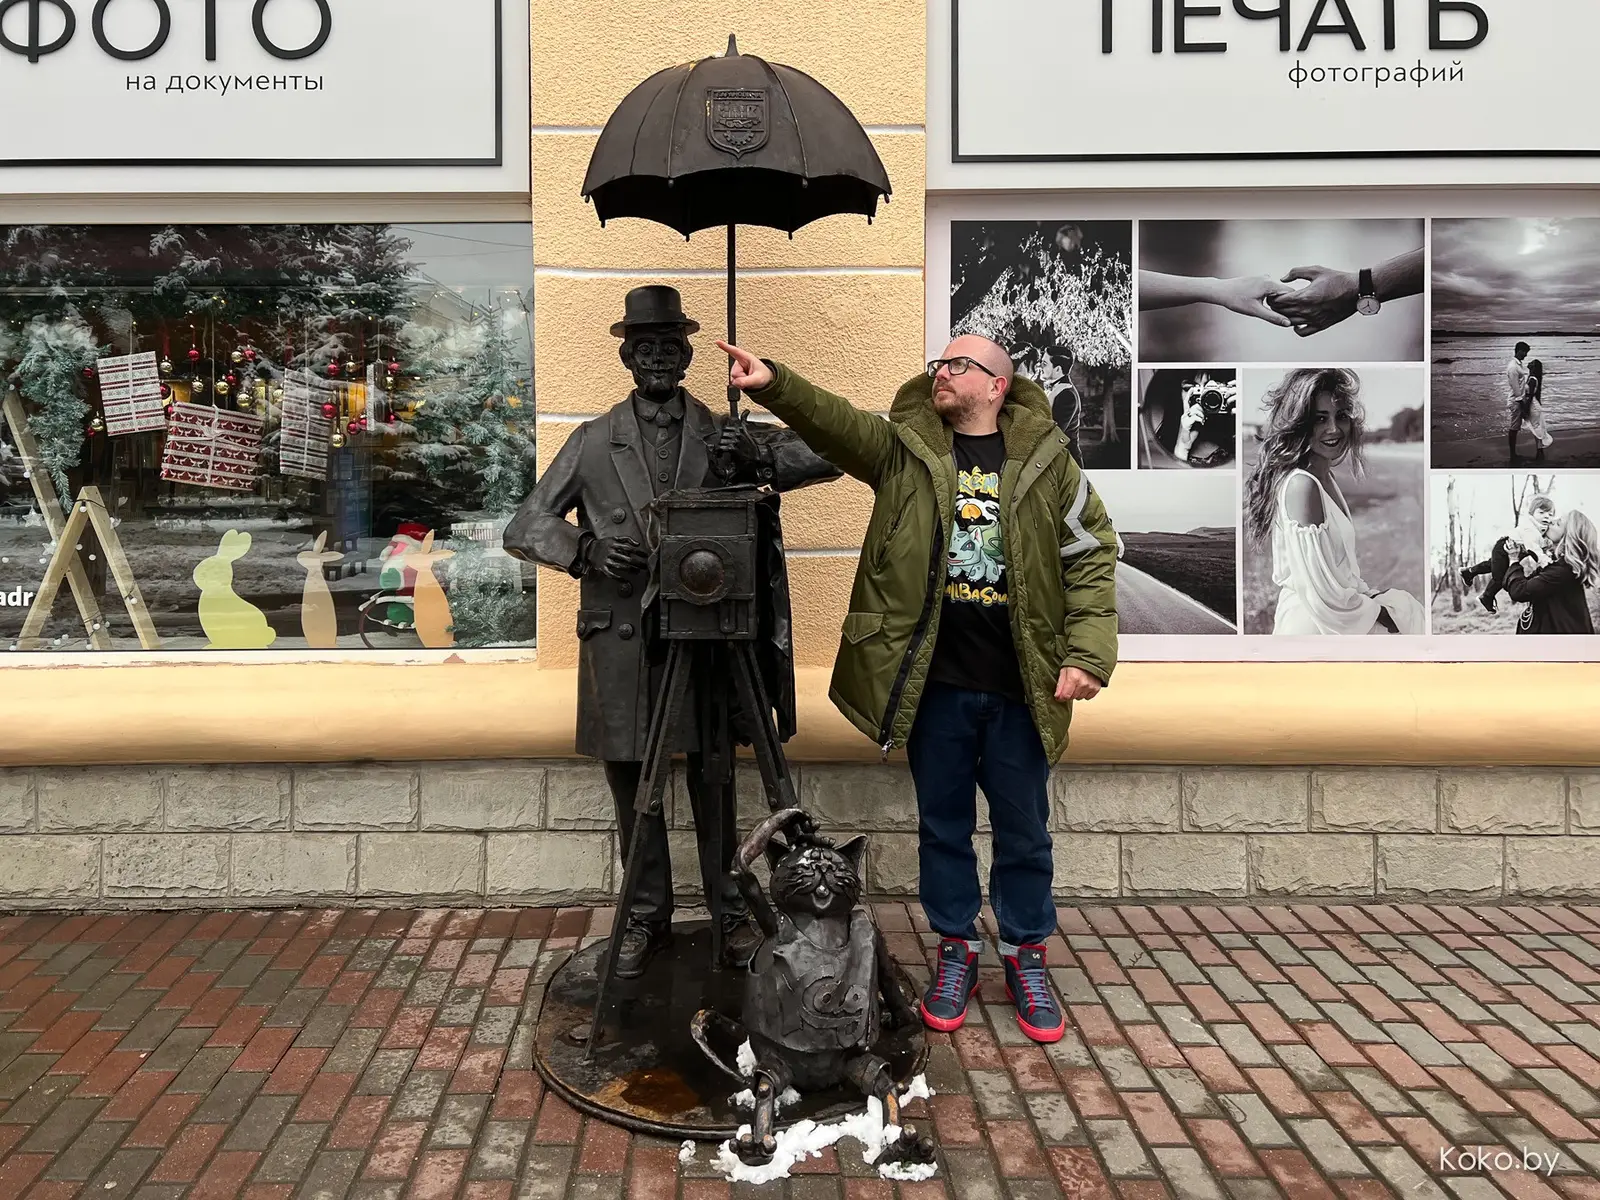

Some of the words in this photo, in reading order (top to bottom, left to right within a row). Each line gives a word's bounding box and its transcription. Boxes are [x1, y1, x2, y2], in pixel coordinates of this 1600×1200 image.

[126, 75, 156, 91] на
[165, 75, 324, 96] документы
[1288, 59, 1465, 88] фотографий
